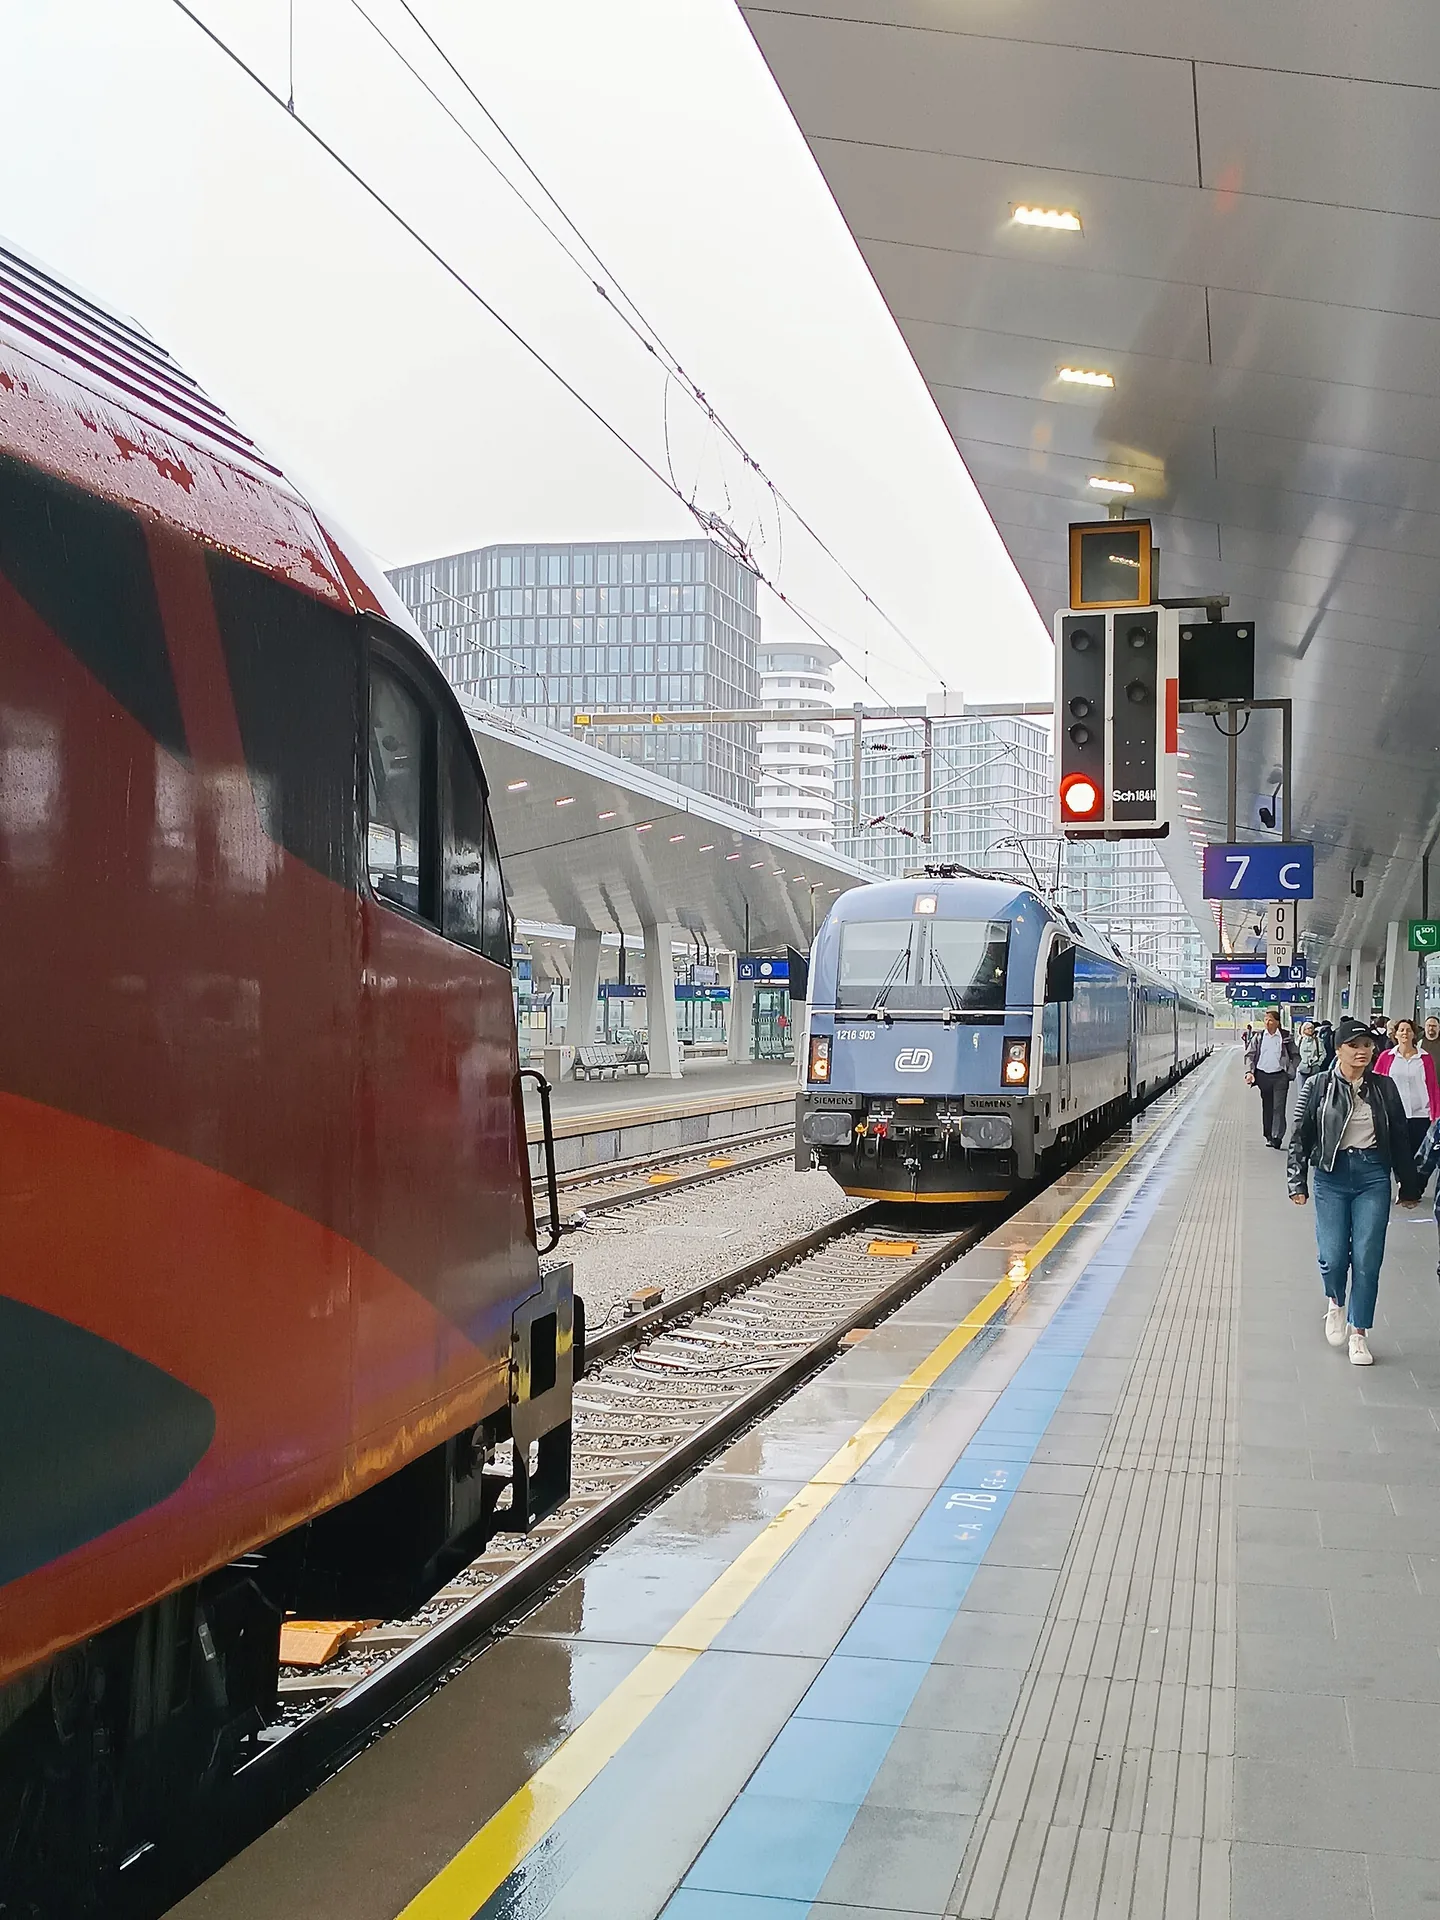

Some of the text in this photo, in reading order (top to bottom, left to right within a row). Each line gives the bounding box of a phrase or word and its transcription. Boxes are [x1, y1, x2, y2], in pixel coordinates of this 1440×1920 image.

[1226, 855, 1300, 889] 7 C
[1276, 907, 1285, 922] 0
[1275, 926, 1284, 941] 0
[1230, 988, 1248, 997] 7 D
[836, 1030, 876, 1040] 1216 903
[813, 1096, 854, 1106] SIEMENS
[969, 1099, 1012, 1108] SIEMENS
[945, 1492, 997, 1511] 7B
